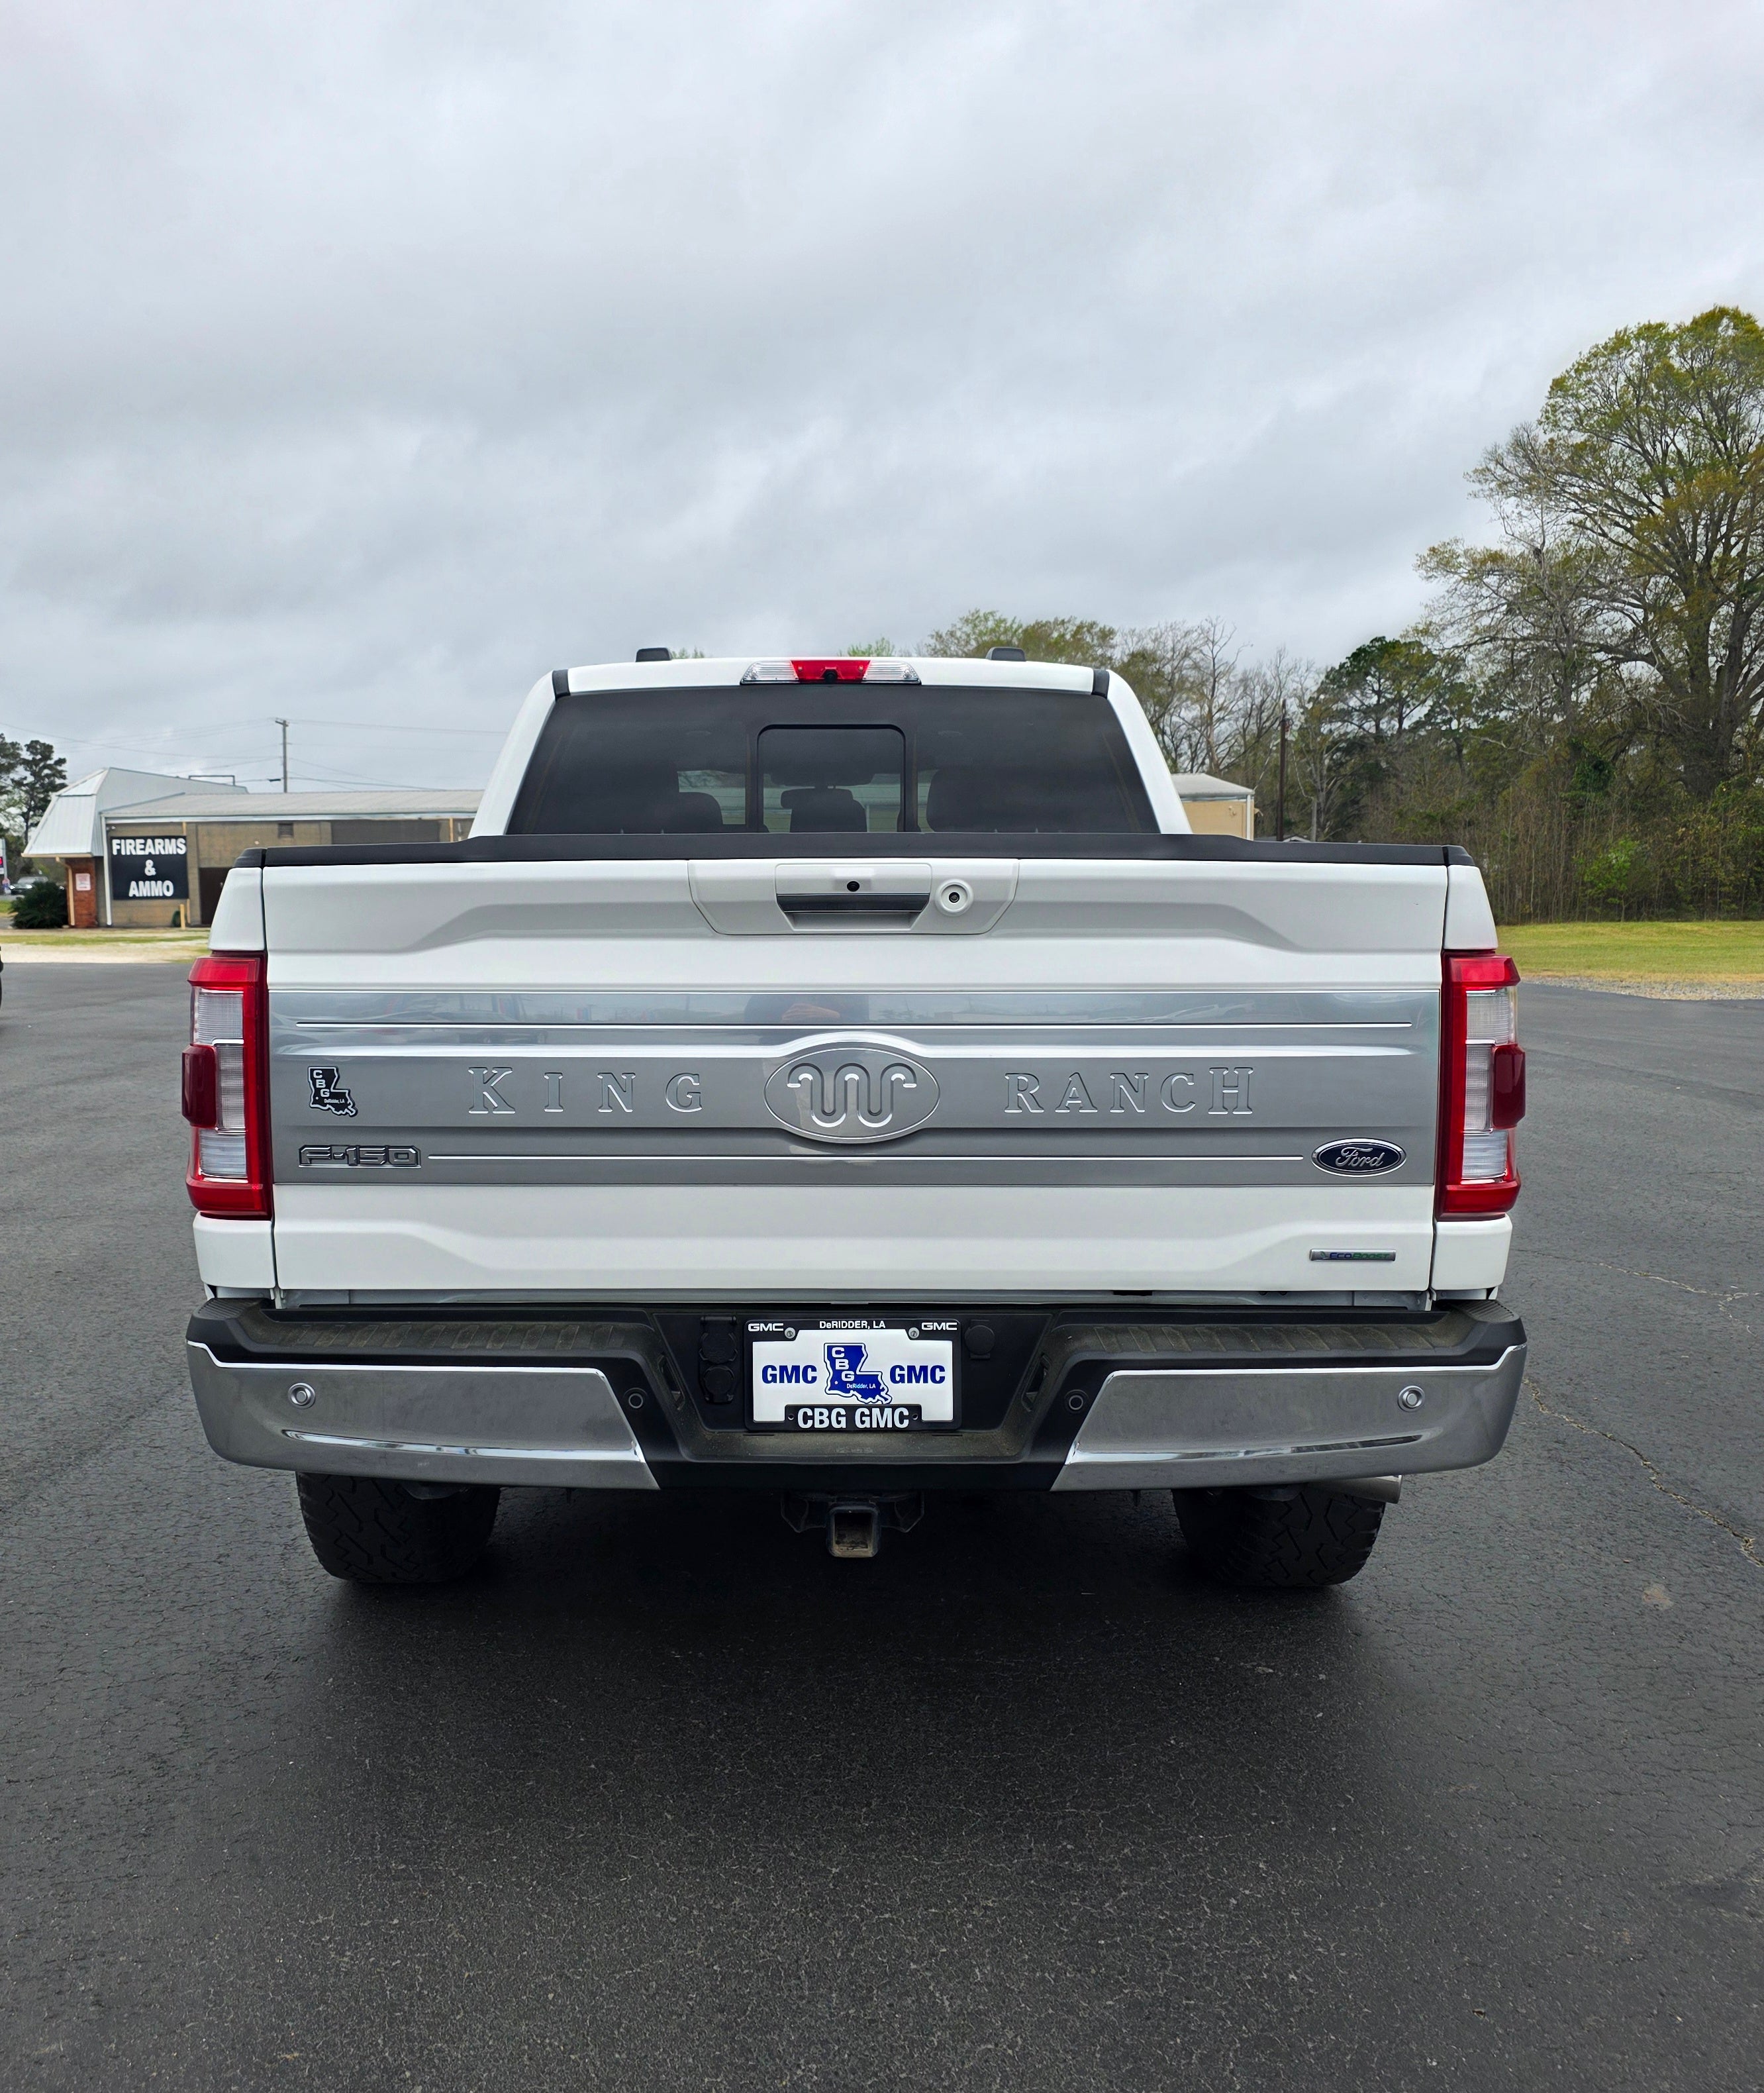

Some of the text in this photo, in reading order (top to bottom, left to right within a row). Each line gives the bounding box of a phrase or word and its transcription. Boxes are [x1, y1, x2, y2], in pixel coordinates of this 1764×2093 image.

[112, 838, 187, 855] FIREARMS
[144, 860, 156, 876] &
[128, 880, 173, 897] AMMO
[467, 1067, 1255, 1115] KING RANCH
[299, 1145, 421, 1167] F-150
[1335, 1147, 1385, 1167] Ford
[748, 1323, 784, 1332] GMC
[819, 1321, 870, 1329] DeRIDDER,
[921, 1322, 957, 1331] GMC
[761, 1364, 817, 1384] GMC
[889, 1364, 946, 1384] GMC
[797, 1407, 909, 1429] CBG GMC
